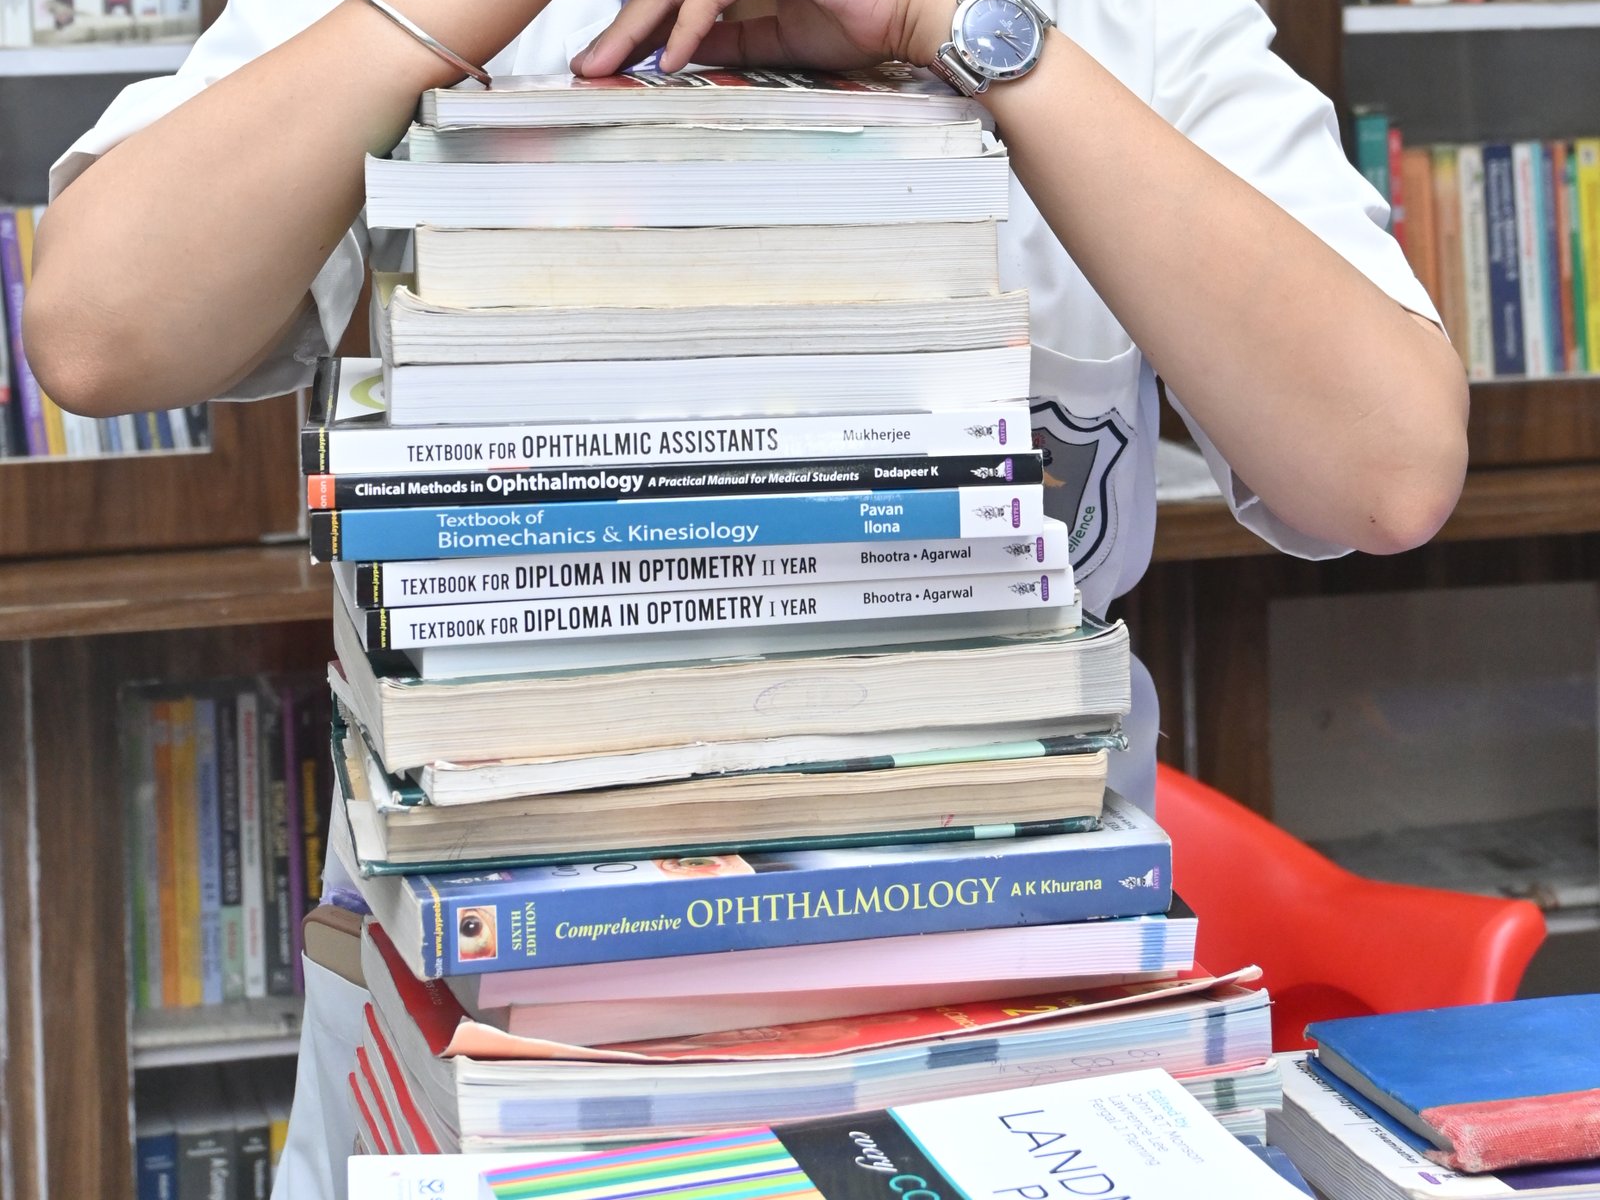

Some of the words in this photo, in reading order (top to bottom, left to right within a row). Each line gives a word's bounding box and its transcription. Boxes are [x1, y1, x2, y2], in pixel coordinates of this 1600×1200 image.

[407, 443, 483, 462] TEXTBOOK
[489, 442, 516, 460] FOR
[522, 432, 652, 459] OPHTHALMIC
[659, 428, 778, 455] ASSISTANTS
[843, 428, 911, 443] Mukherjee
[355, 482, 405, 497] Clinical
[408, 481, 469, 496] Methods
[470, 480, 483, 493] in
[486, 473, 643, 497] Ophthalmology
[648, 478, 657, 488] A
[658, 474, 709, 488] Practical
[710, 473, 749, 486] Manual
[749, 472, 766, 485] for
[767, 471, 811, 484] Medical
[812, 470, 860, 483] Students
[874, 466, 928, 481] Dadapeer
[930, 466, 939, 477] K
[437, 513, 521, 528] Textbook
[525, 510, 545, 525] of
[860, 503, 903, 516] Pavan
[438, 527, 596, 549] Biomechanics
[602, 526, 622, 543] &
[628, 521, 759, 545] Kinesiology
[864, 520, 900, 534] Ilona
[860, 550, 910, 564] Bhootra
[920, 546, 972, 563] Agarwal
[401, 576, 477, 596] TEXTBOOK
[482, 573, 509, 591] FOR
[515, 562, 604, 589] DIPLOMA
[612, 561, 631, 584] IN
[639, 554, 756, 582] OPTOMETRY
[762, 560, 775, 576] II
[780, 557, 817, 575] YEAR
[863, 591, 912, 605] Bhootra
[922, 586, 973, 603] Agarwal
[410, 620, 485, 640] TEXTBOOK
[491, 617, 518, 635] FOR
[524, 606, 613, 633] DIPLOMA
[620, 603, 639, 626] IN
[647, 595, 763, 624] OPTOMETRY
[769, 600, 776, 617] I
[780, 598, 817, 616] YEAR
[1010, 883, 1022, 897] A
[1025, 882, 1036, 896] K
[1041, 877, 1102, 894] Khurana
[555, 914, 682, 941] Comprehensive
[686, 876, 1002, 928] OPHTHALMOLOGY
[511, 910, 523, 951] SIXTH
[526, 901, 537, 957] EDITION
[1147, 1089, 1180, 1116] Edited
[998, 1109, 1131, 1200] LAND
